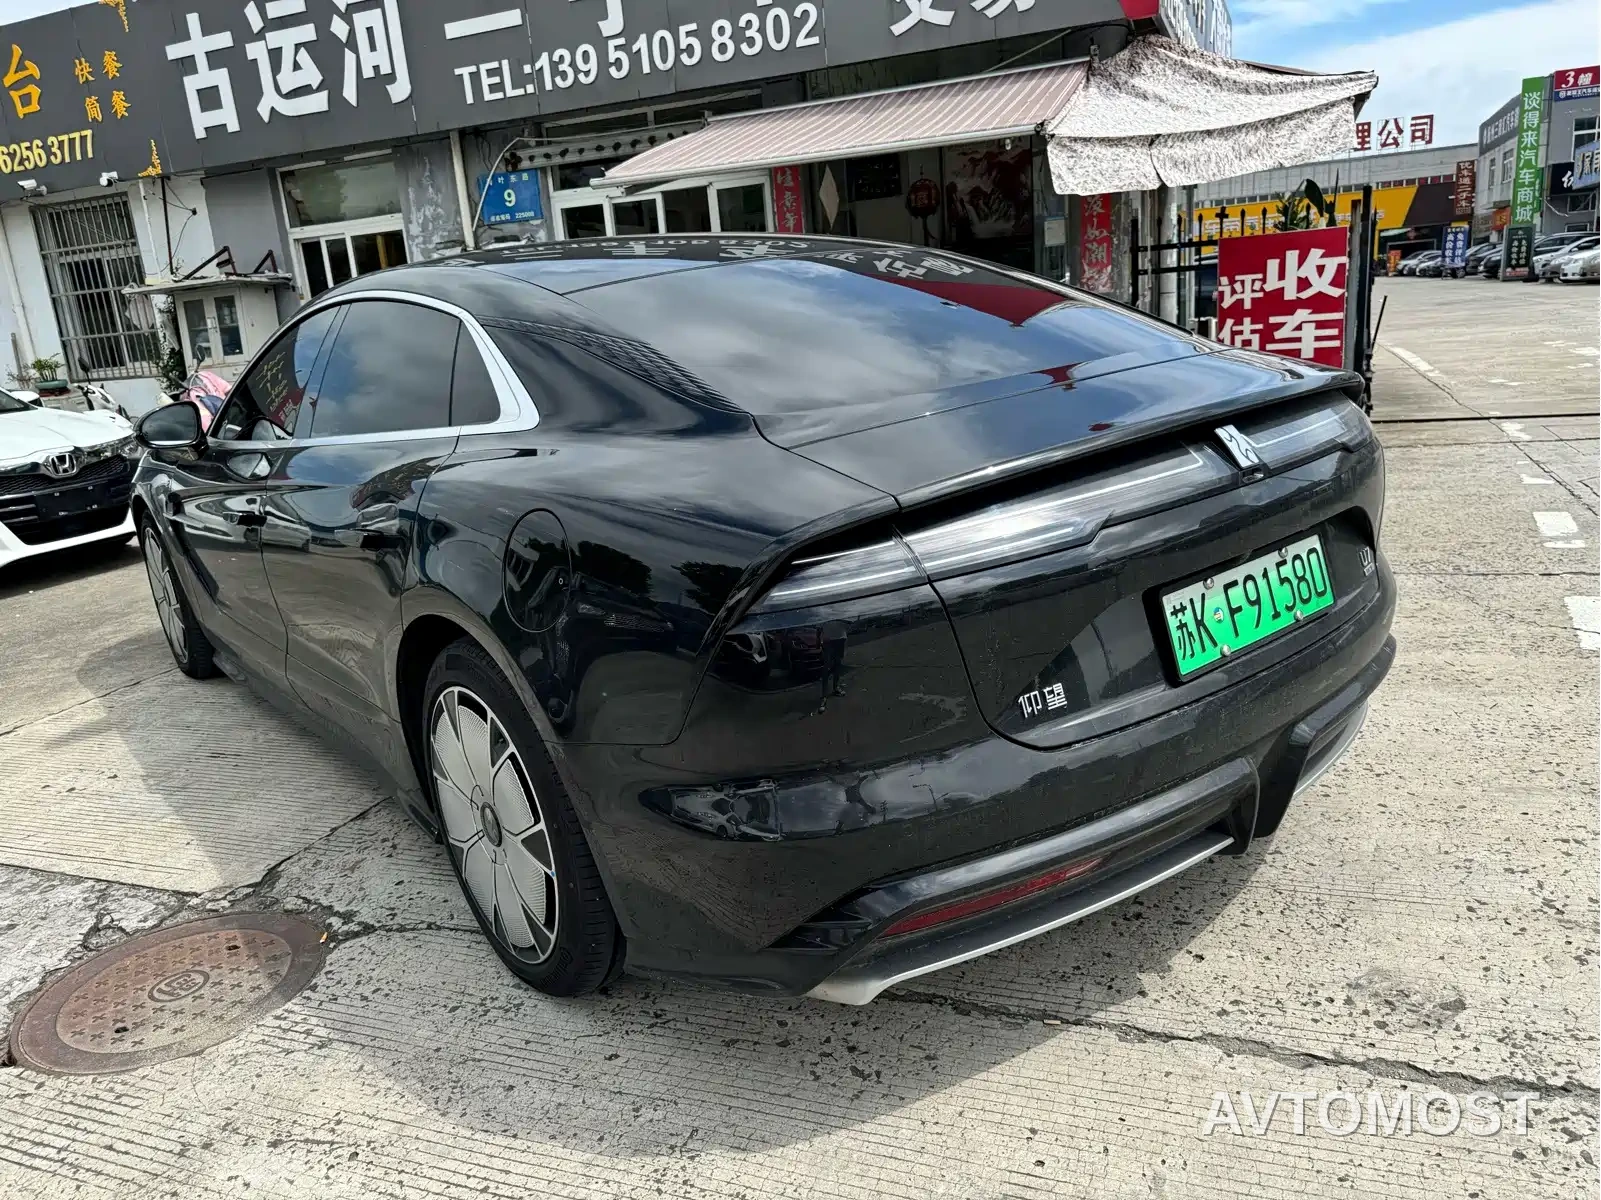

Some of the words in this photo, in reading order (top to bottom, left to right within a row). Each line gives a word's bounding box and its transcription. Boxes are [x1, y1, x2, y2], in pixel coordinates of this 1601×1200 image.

[608, 22, 703, 79] 5105
[711, 2, 821, 62] 8302
[74, 50, 122, 84] 快餐
[85, 90, 131, 122] 简餐
[47, 129, 94, 165] 3777
[1515, 91, 1541, 222] 谈得来汽车商城
[503, 188, 516, 207] 9
[1018, 682, 1068, 719] 仰望
